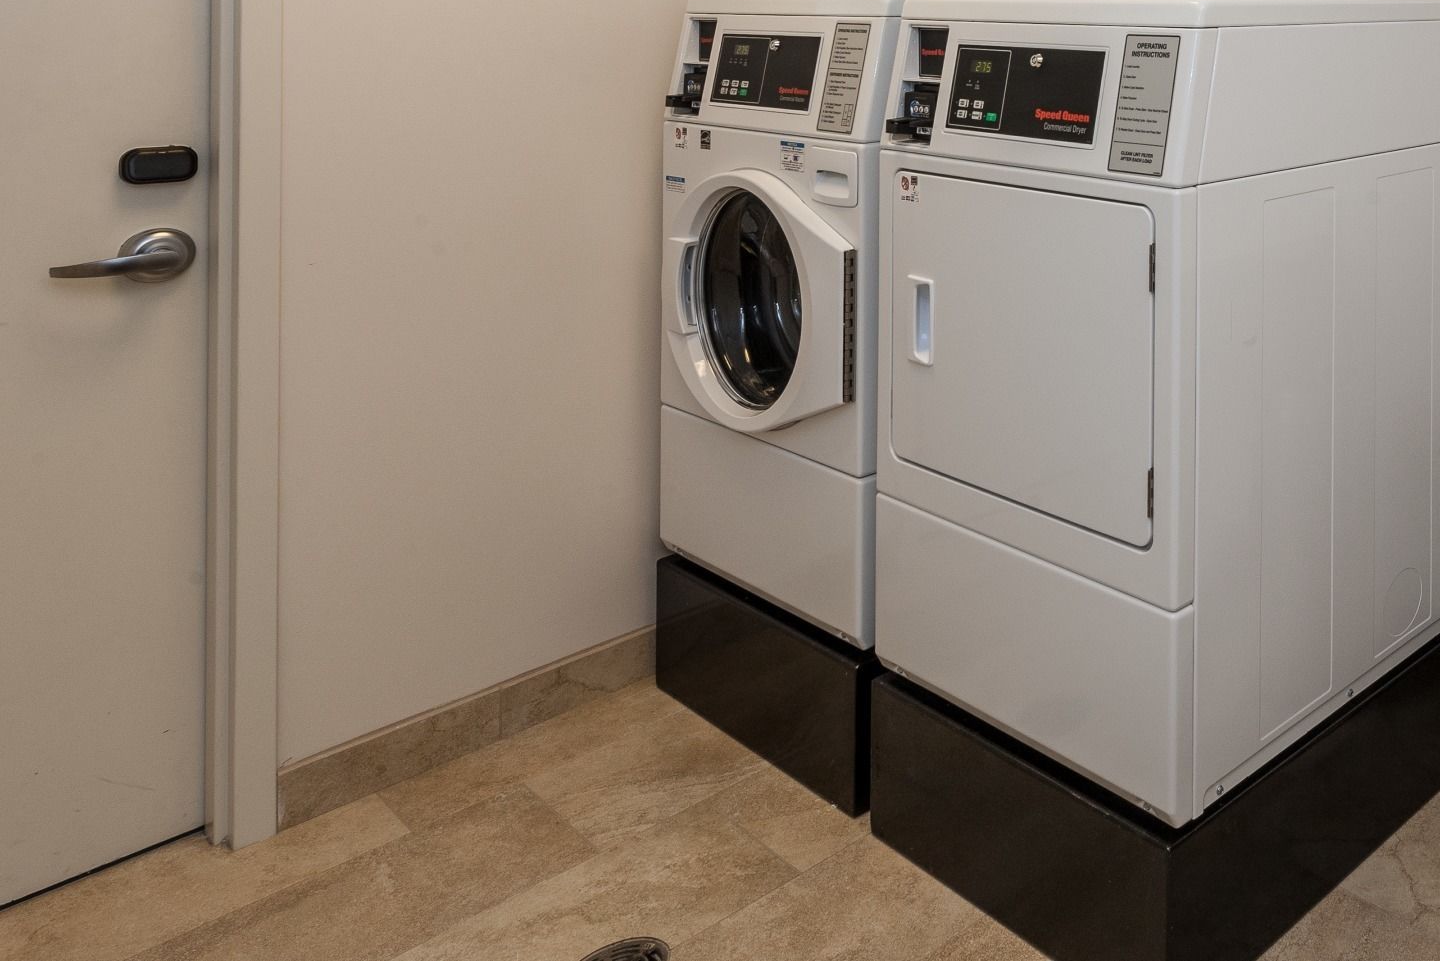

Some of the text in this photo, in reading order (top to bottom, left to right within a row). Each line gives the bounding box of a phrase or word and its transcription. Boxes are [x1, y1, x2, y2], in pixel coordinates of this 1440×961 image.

[1136, 42, 1167, 50] OPERATING
[1131, 50, 1170, 58] INSTRUCTIONS
[1035, 108, 1090, 123] Speed Queen
[1043, 122, 1087, 135] Commercial Dryer
